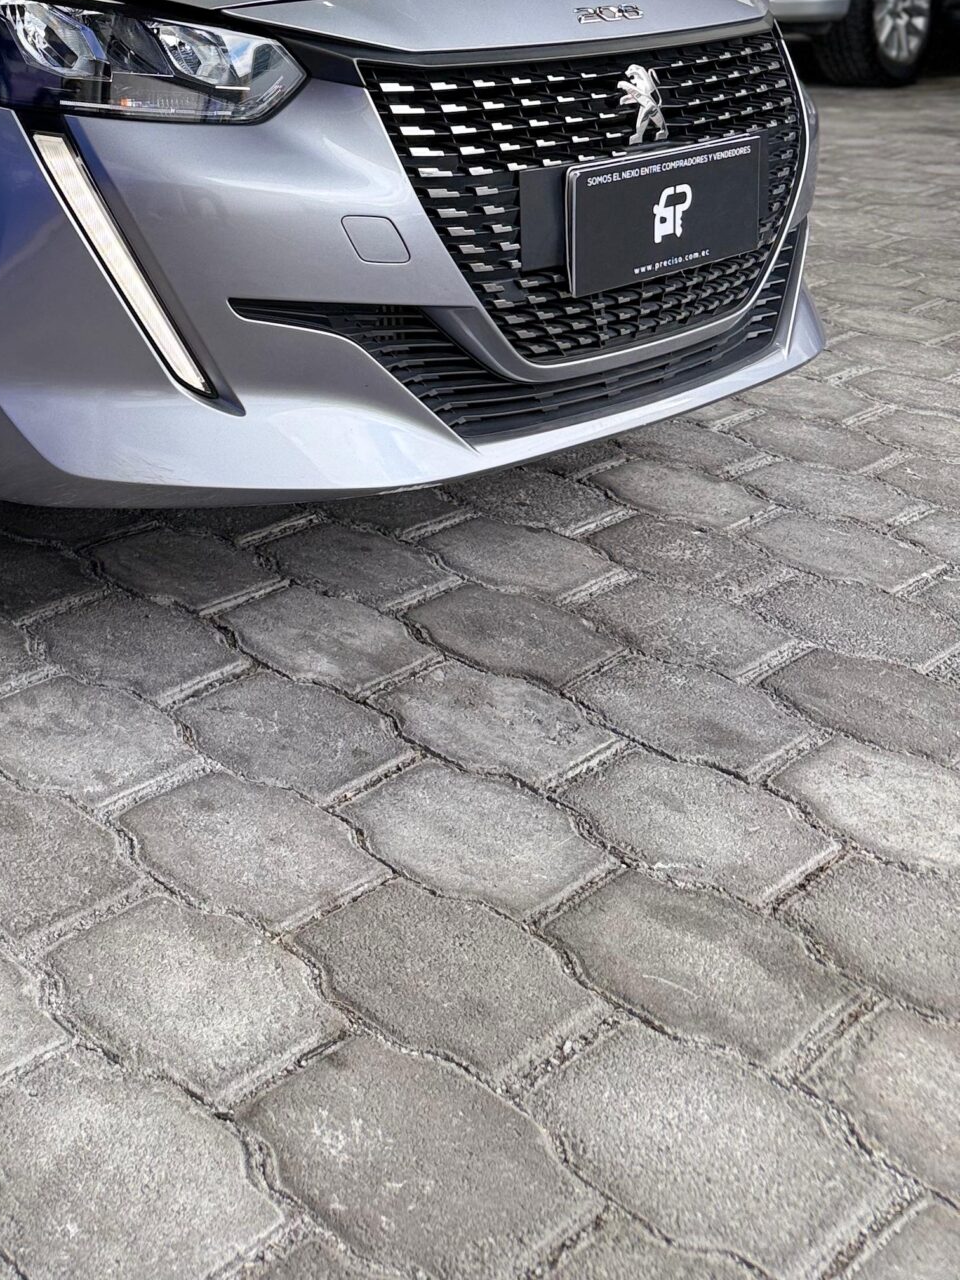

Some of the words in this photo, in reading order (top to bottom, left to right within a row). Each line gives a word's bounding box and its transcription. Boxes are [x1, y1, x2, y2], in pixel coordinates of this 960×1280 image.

[572, 3, 644, 24] 208
[587, 174, 612, 187] SOMOS
[613, 172, 621, 181] EL
[622, 168, 640, 180] NEXO
[640, 163, 662, 176] ENTRE
[661, 154, 708, 172] COMPRADORES
[708, 153, 713, 162] Y
[713, 145, 751, 161] VENDEDORES
[633, 249, 710, 275] www.preciso.com.ec
